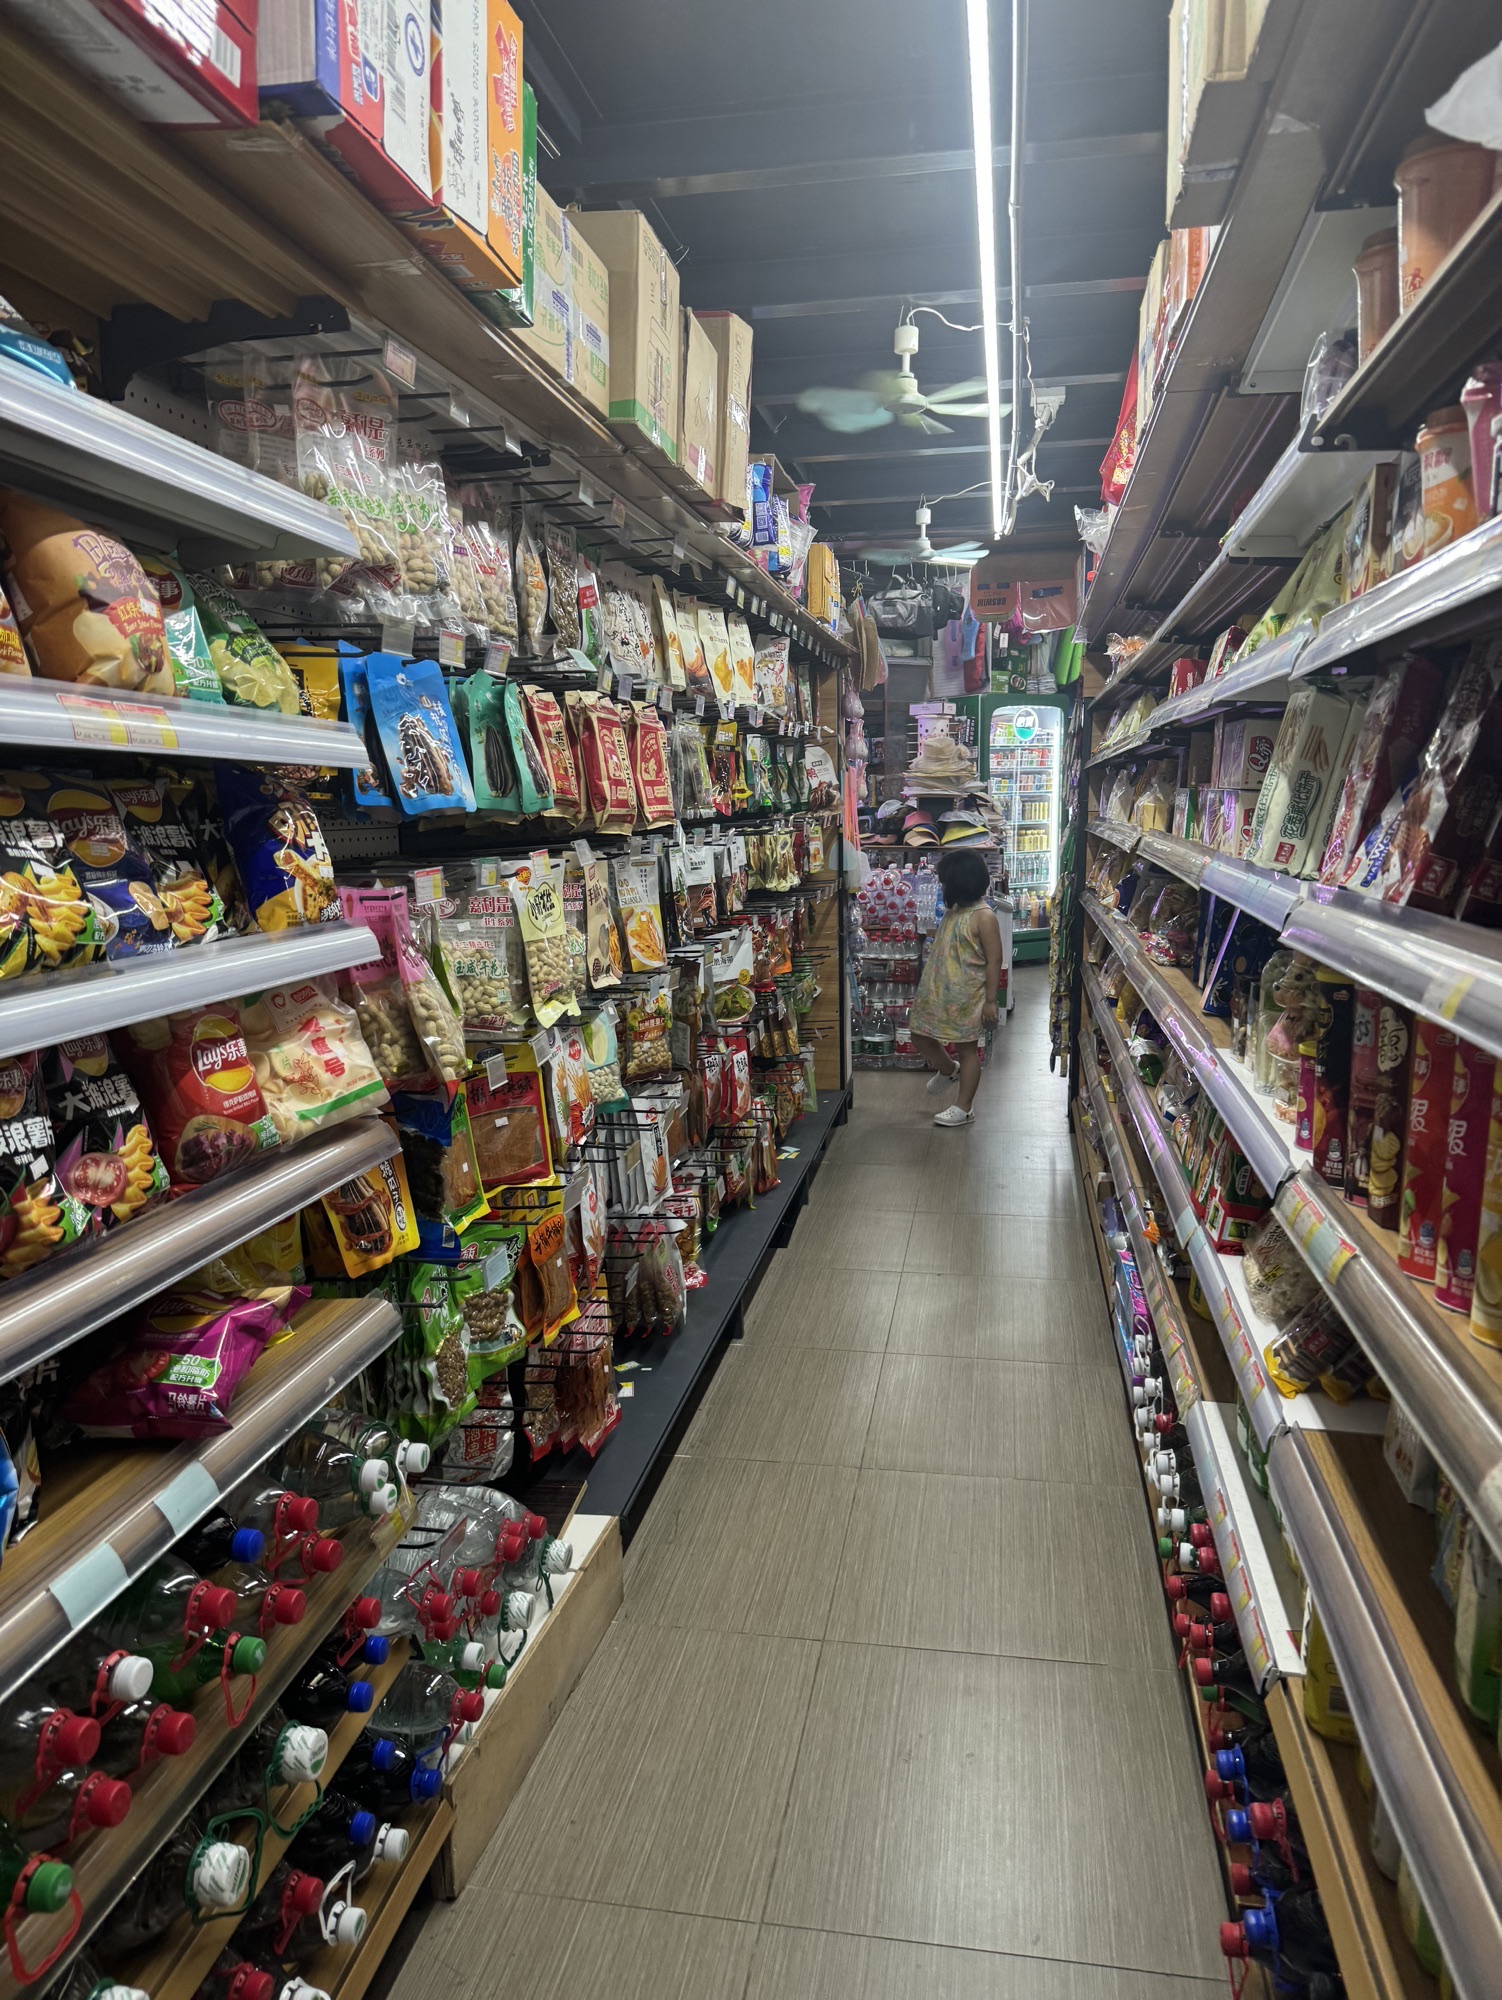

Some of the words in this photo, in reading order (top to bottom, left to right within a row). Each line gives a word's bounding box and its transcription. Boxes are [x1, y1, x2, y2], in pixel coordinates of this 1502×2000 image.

[1280, 770, 1317, 841] 花卷威化饼干
[94, 814, 122, 835] 乐事
[469, 896, 512, 914] 嘉利是
[197, 1043, 228, 1071] Lay's
[226, 1038, 247, 1061] 乐事
